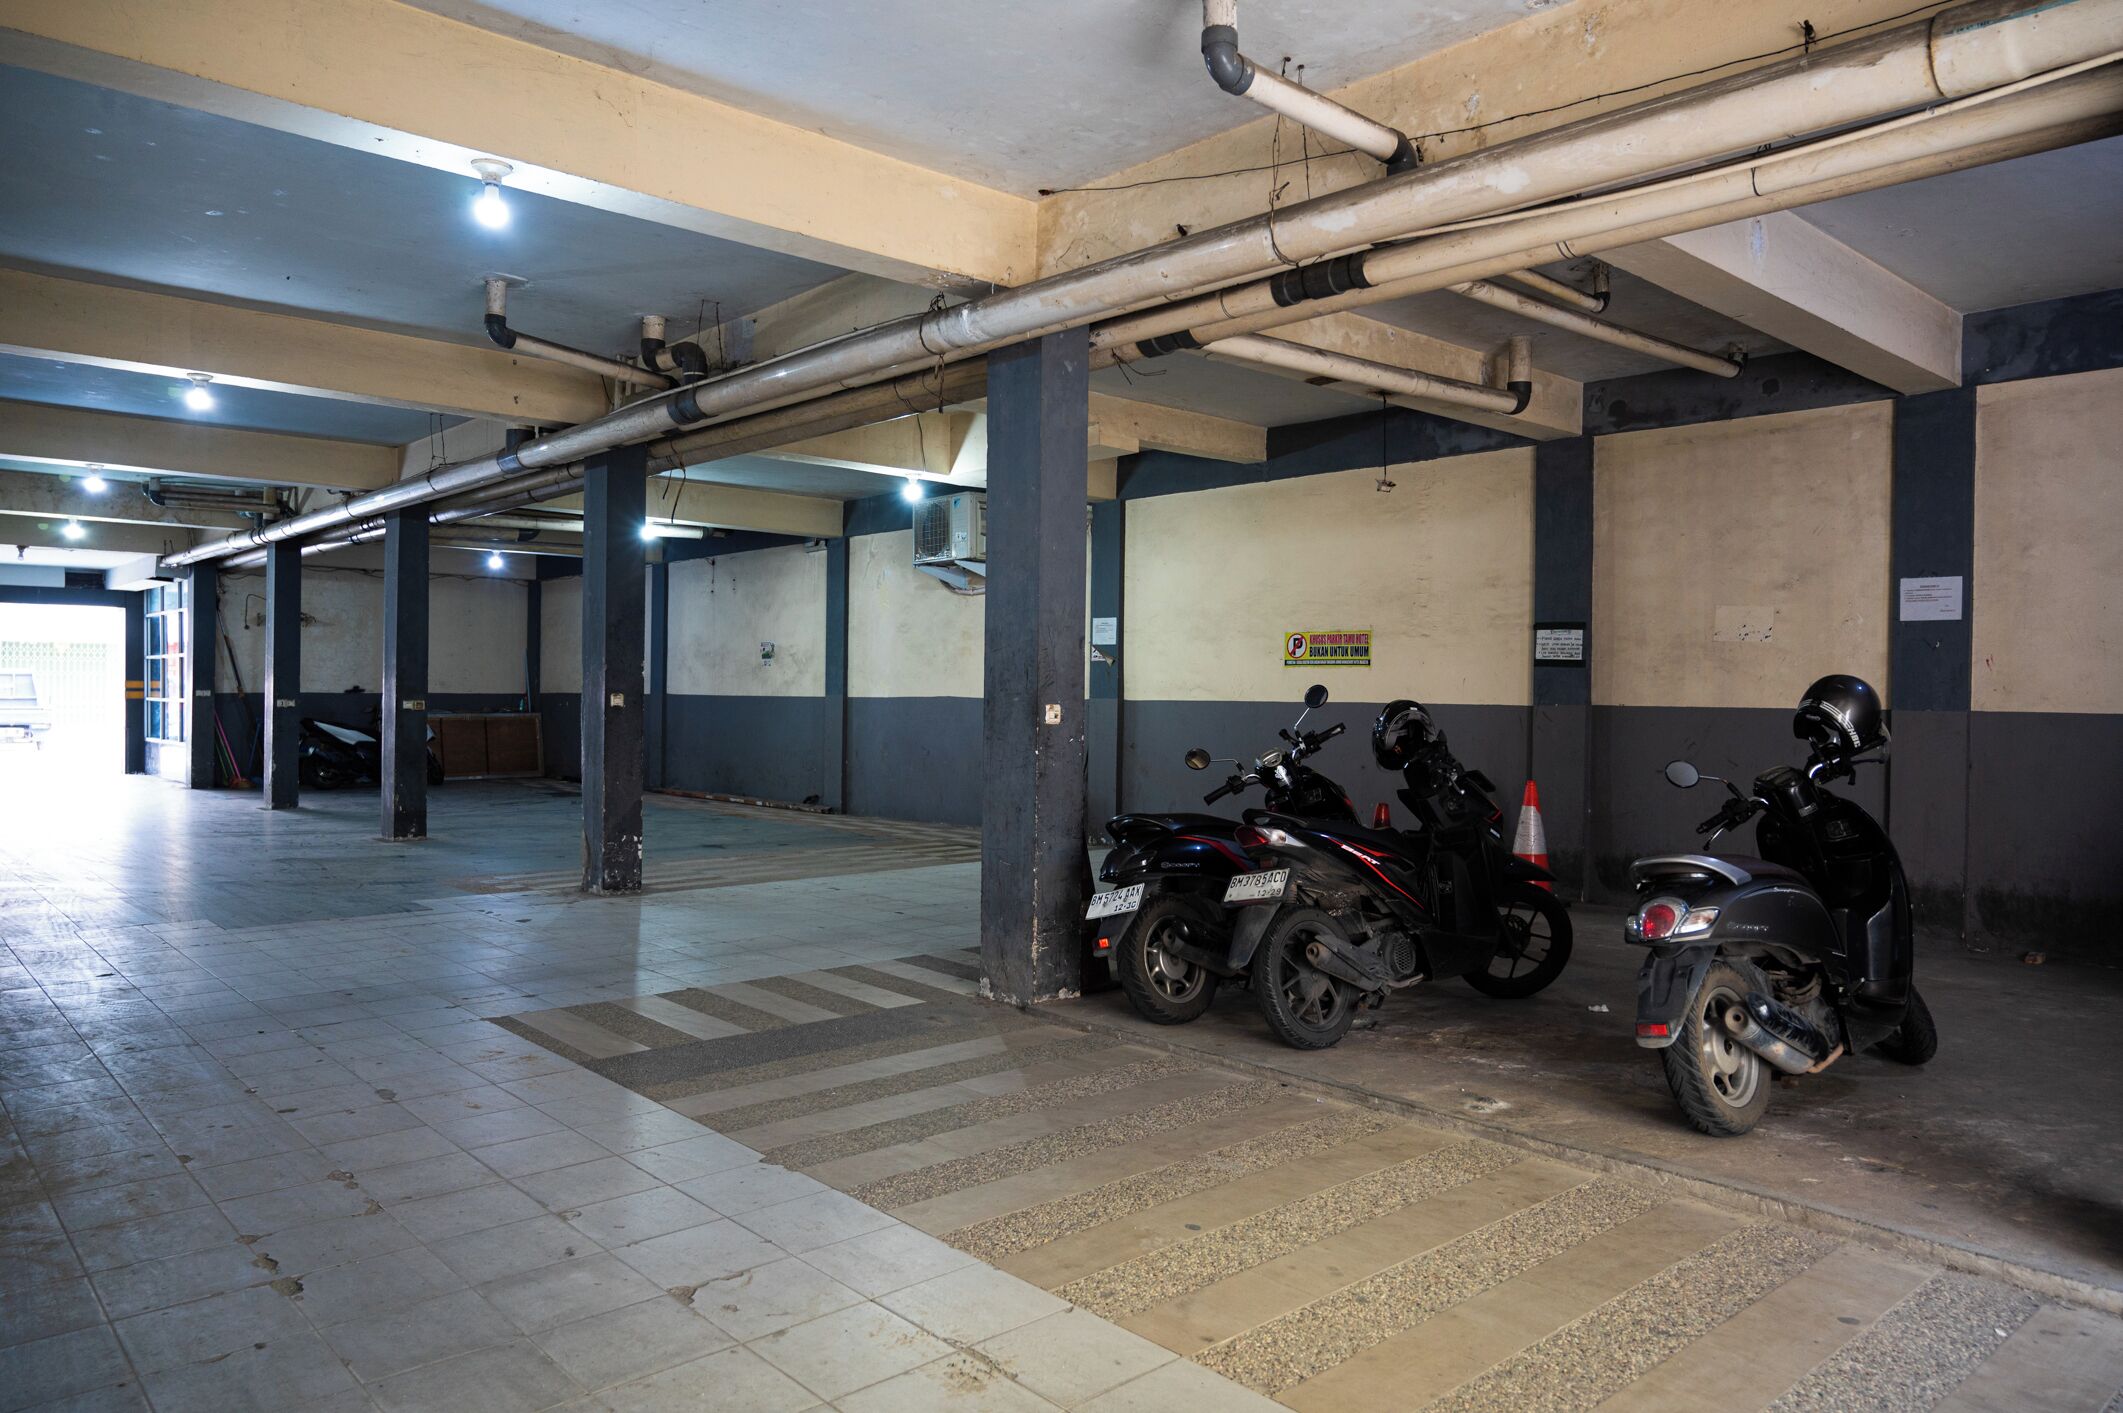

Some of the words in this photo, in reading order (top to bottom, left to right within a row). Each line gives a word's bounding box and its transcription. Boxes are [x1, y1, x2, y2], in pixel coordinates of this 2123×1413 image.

[1309, 646, 1329, 657] BUKAN
[1330, 646, 1348, 657] UNTUK
[1350, 646, 1369, 657] UMUM
[1091, 895, 1104, 906] BM
[1104, 890, 1124, 904] 5724
